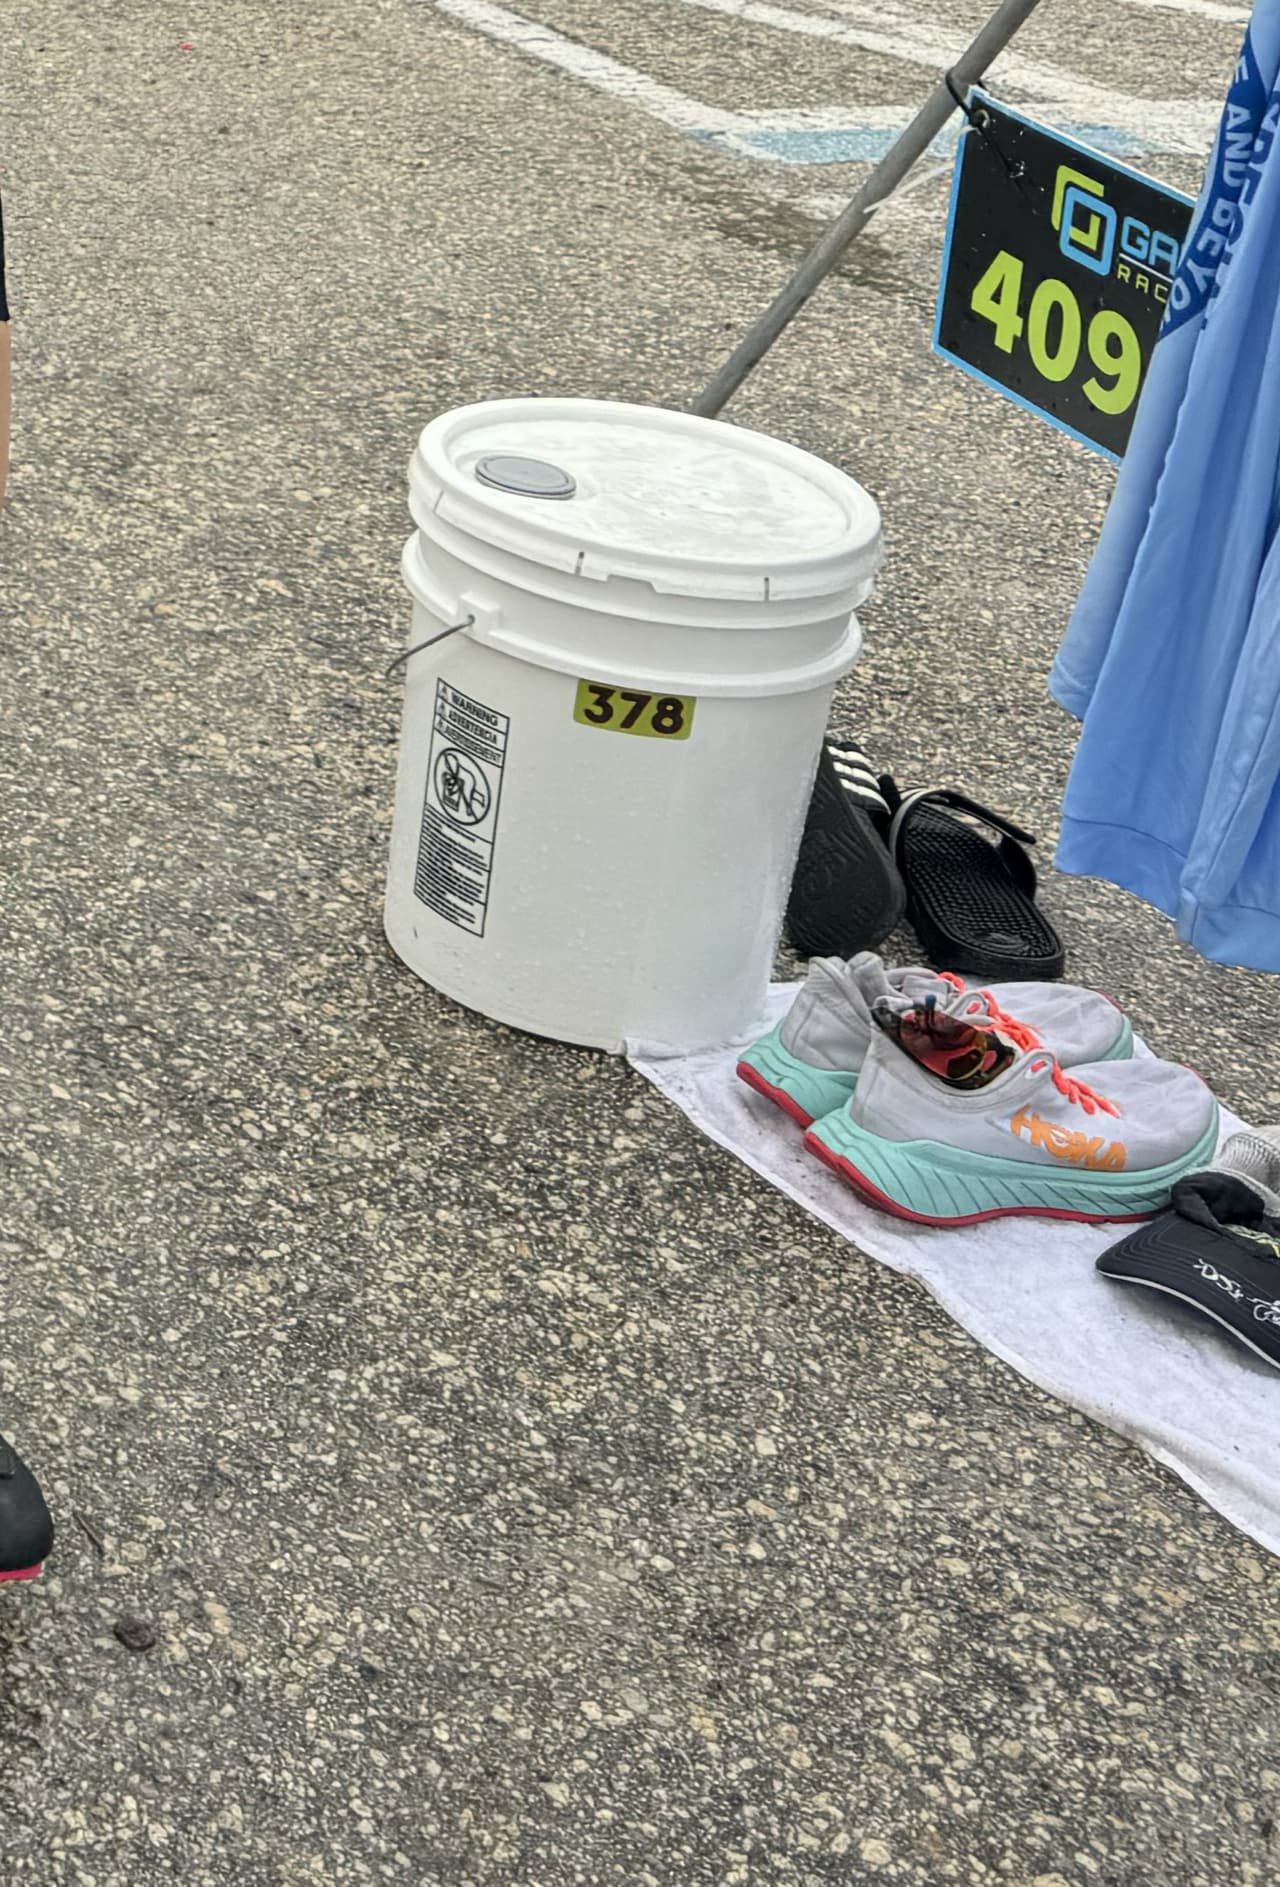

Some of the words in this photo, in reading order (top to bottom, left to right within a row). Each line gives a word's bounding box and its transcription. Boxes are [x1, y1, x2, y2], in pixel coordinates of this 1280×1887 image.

[1222, 102, 1253, 192] AND
[970, 250, 1142, 415] 409
[450, 691, 498, 727] WARNING
[583, 684, 685, 735] 378
[1009, 1103, 1128, 1171] HOKA
